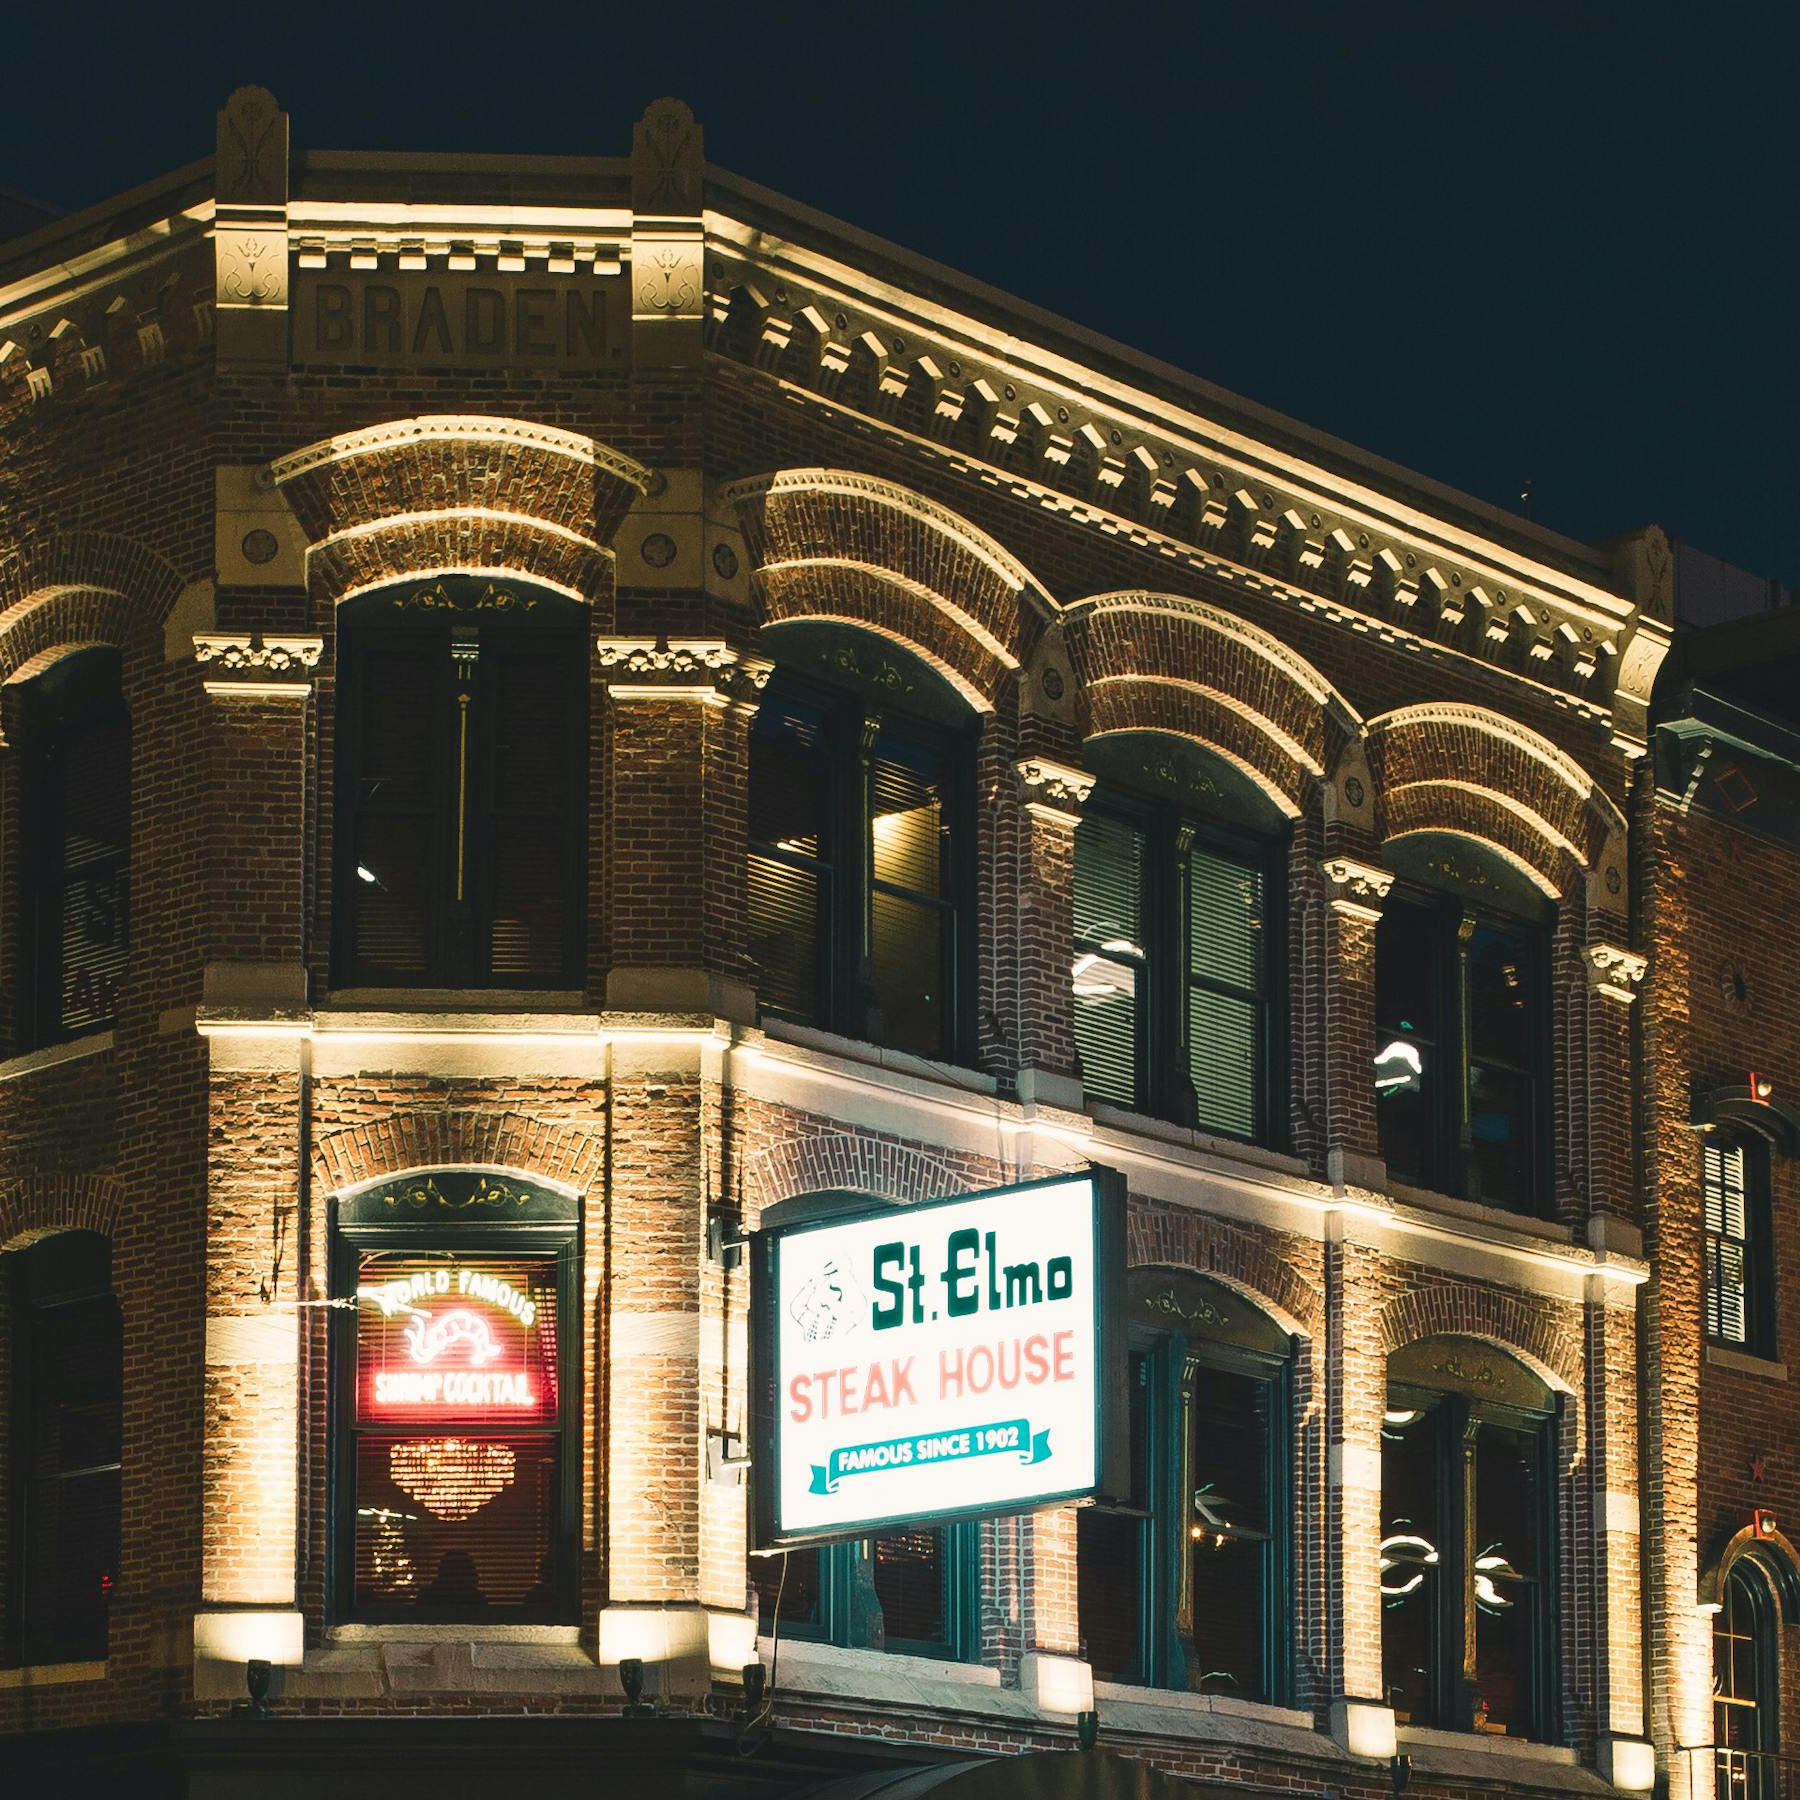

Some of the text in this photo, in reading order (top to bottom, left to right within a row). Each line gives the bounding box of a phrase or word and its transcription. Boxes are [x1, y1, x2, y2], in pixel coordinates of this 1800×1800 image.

[459, 1270, 536, 1326] FAMOUS
[872, 1227, 1073, 1331] St. Elmo
[444, 1372, 535, 1405] COCKTAIL
[789, 1330, 1075, 1424] STEAK HOUSE
[837, 1426, 1019, 1472] FAMOUS SINCE 1902
